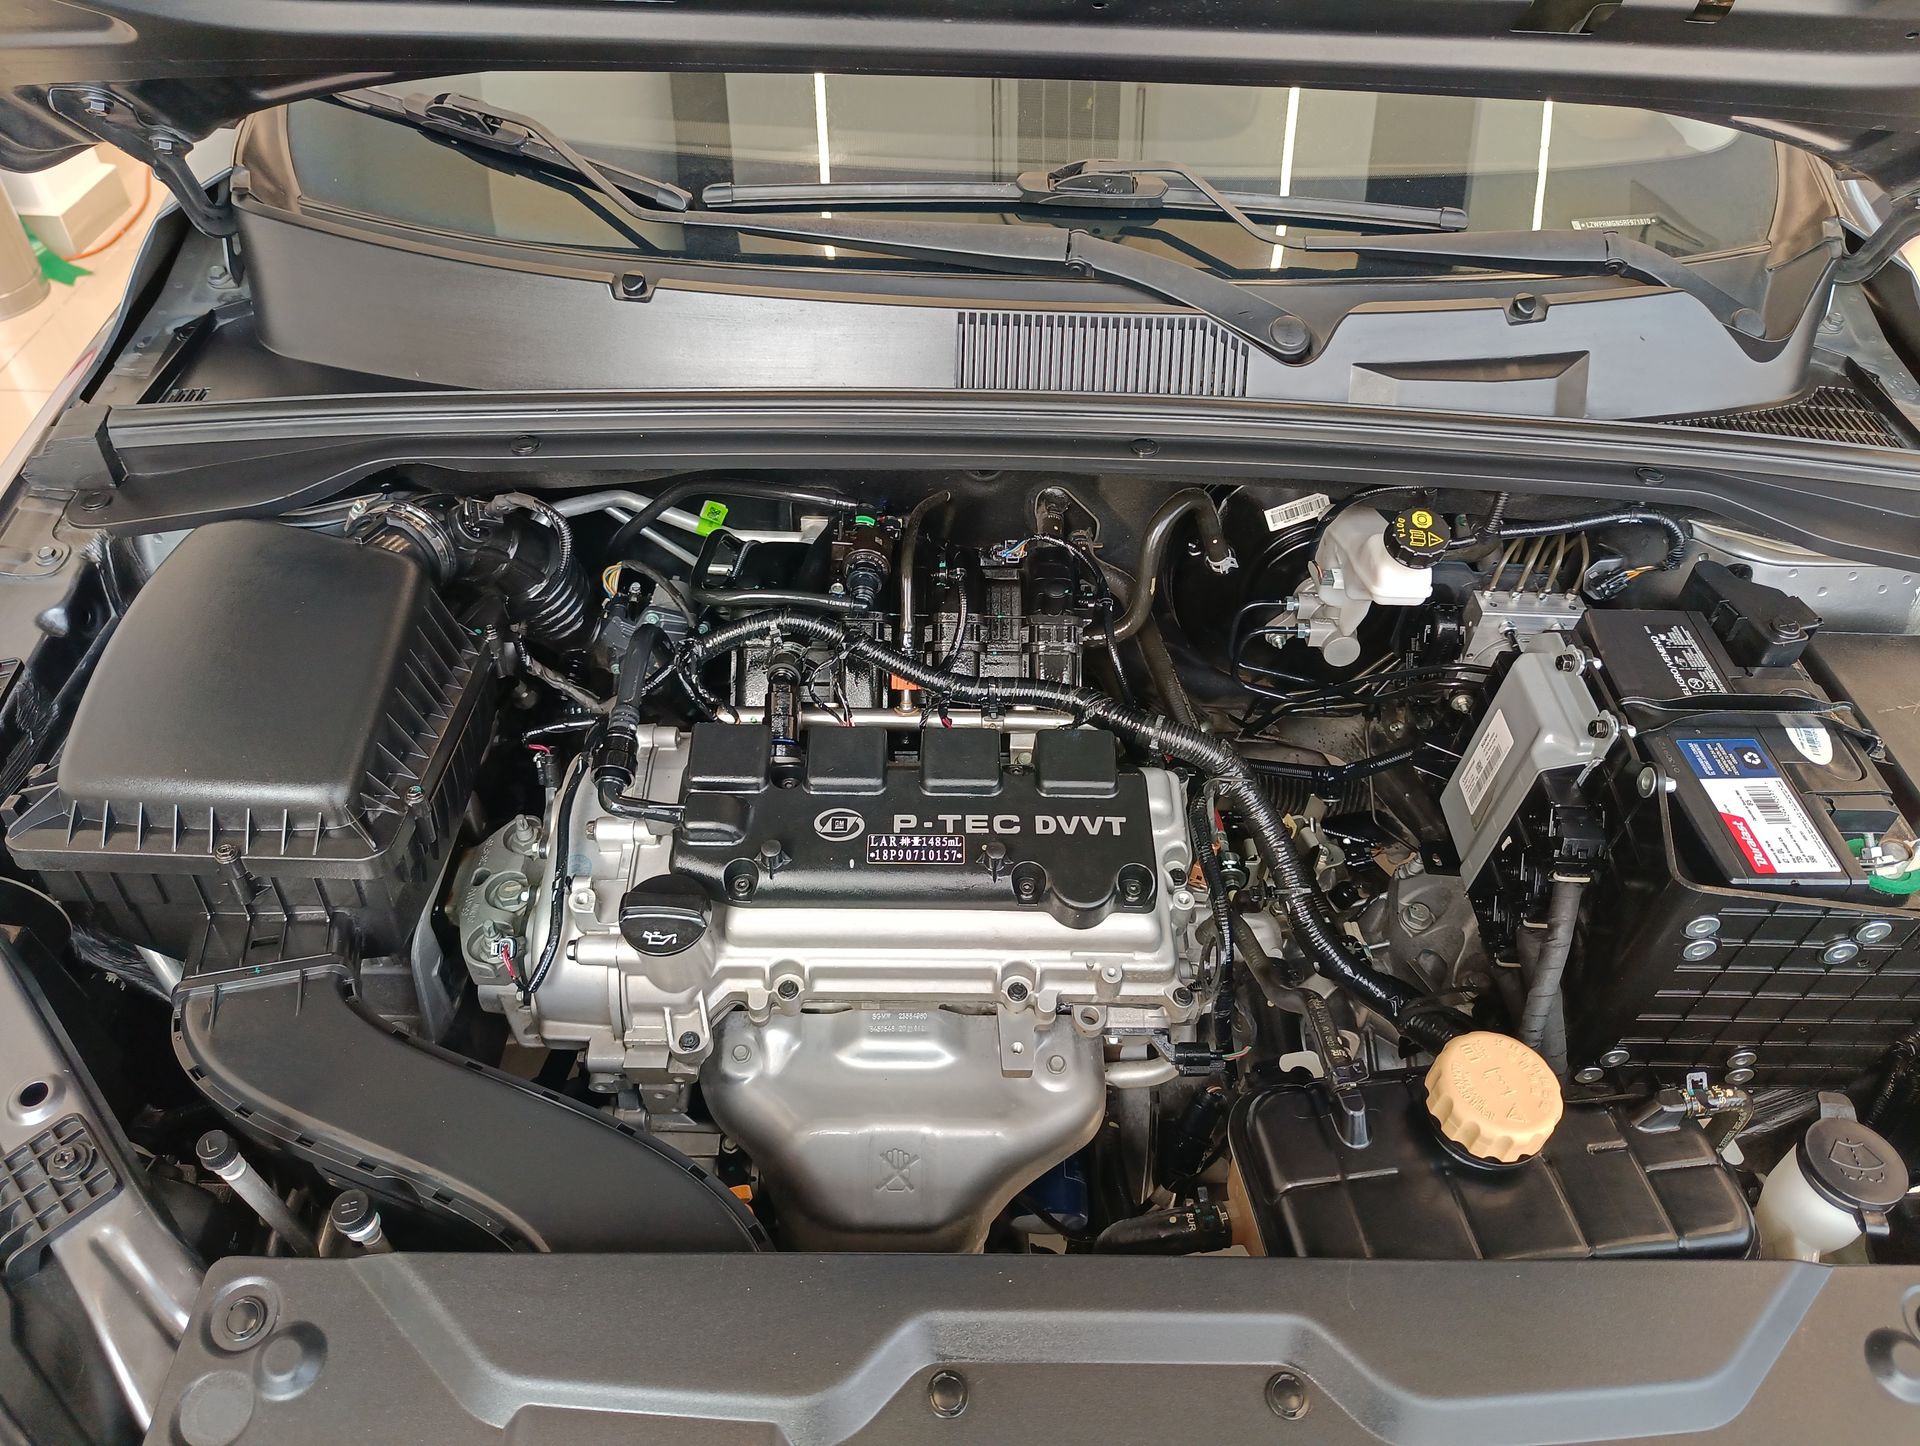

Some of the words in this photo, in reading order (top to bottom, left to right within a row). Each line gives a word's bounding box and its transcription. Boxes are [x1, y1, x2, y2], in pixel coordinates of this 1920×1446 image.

[893, 814, 1021, 835] P-TEC
[1034, 816, 1127, 836] DVVT
[870, 835, 897, 847] LAR
[1731, 820, 1769, 868] Duralast
